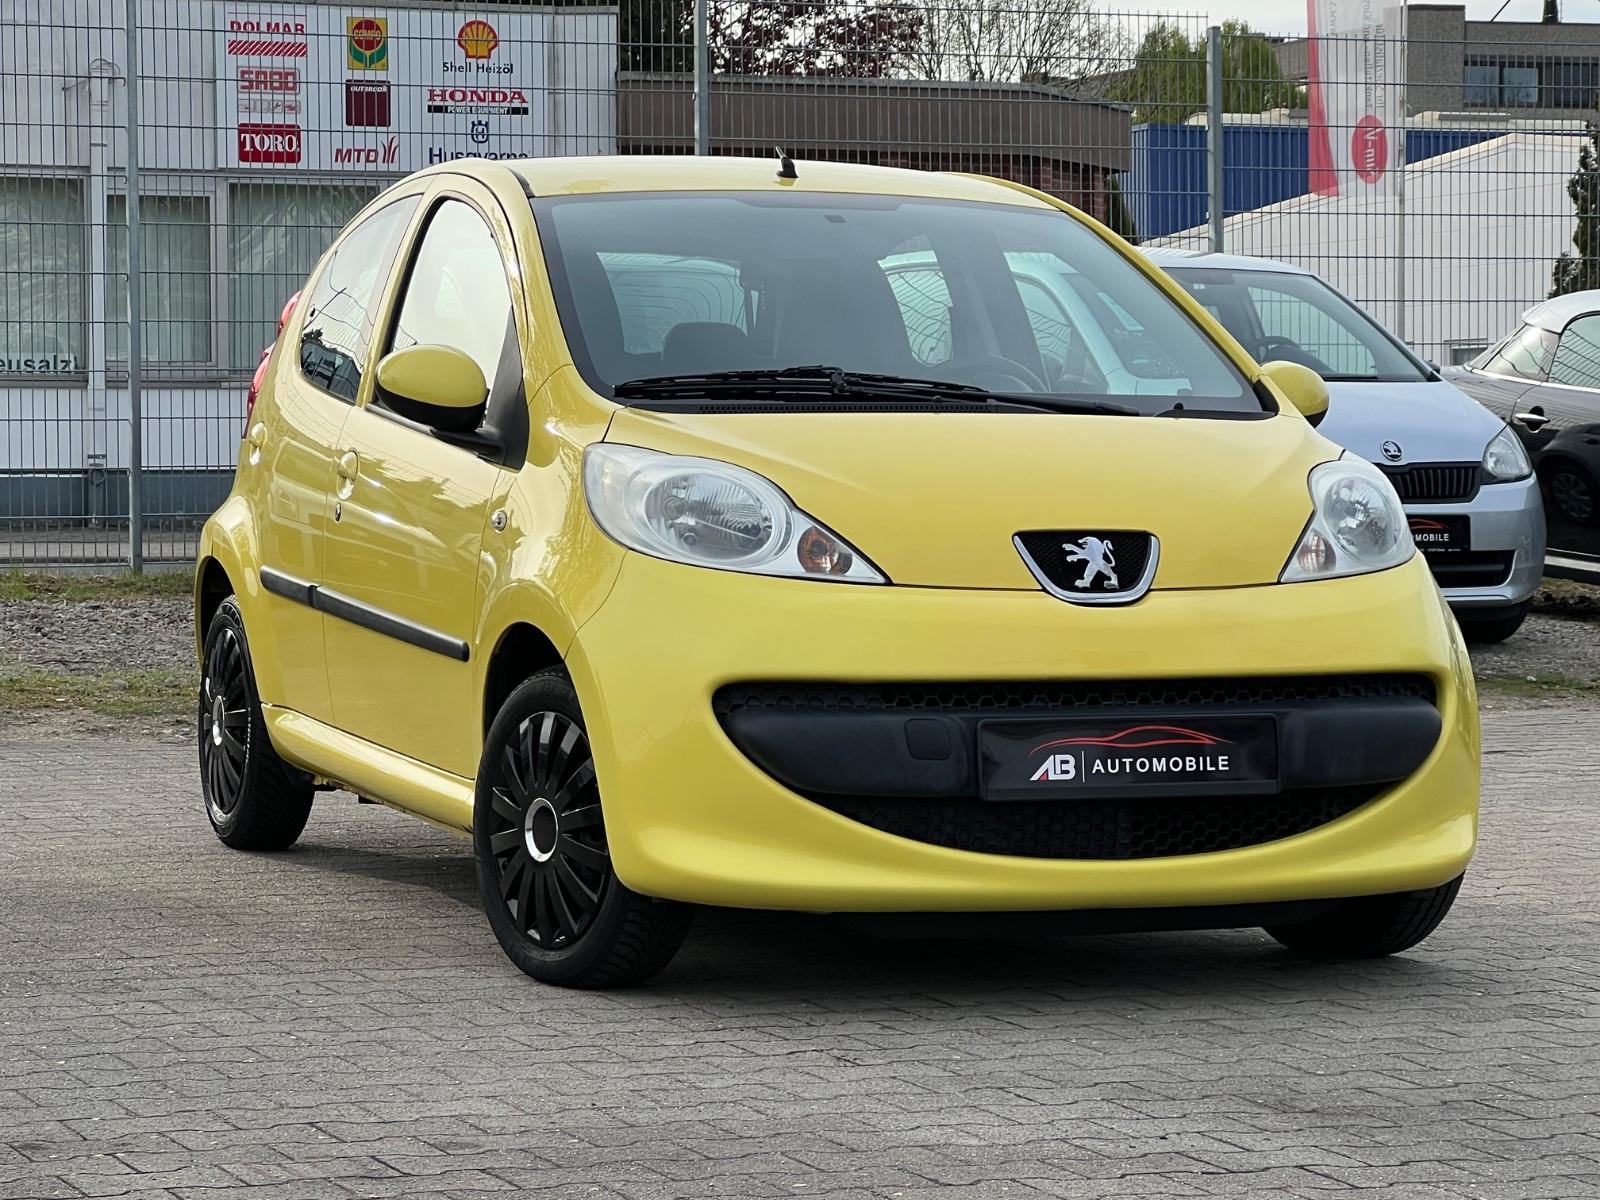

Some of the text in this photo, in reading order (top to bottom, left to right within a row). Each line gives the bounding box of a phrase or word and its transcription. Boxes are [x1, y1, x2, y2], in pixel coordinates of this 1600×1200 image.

[230, 20, 305, 35] DOLMAR
[443, 62, 514, 74] Shell Heizöl
[427, 88, 529, 103] HONDA
[241, 133, 298, 152] TORO
[335, 147, 379, 163] MTD
[1412, 533, 1450, 542] MOBILE
[1092, 755, 1230, 774] AUTOMOBILE
